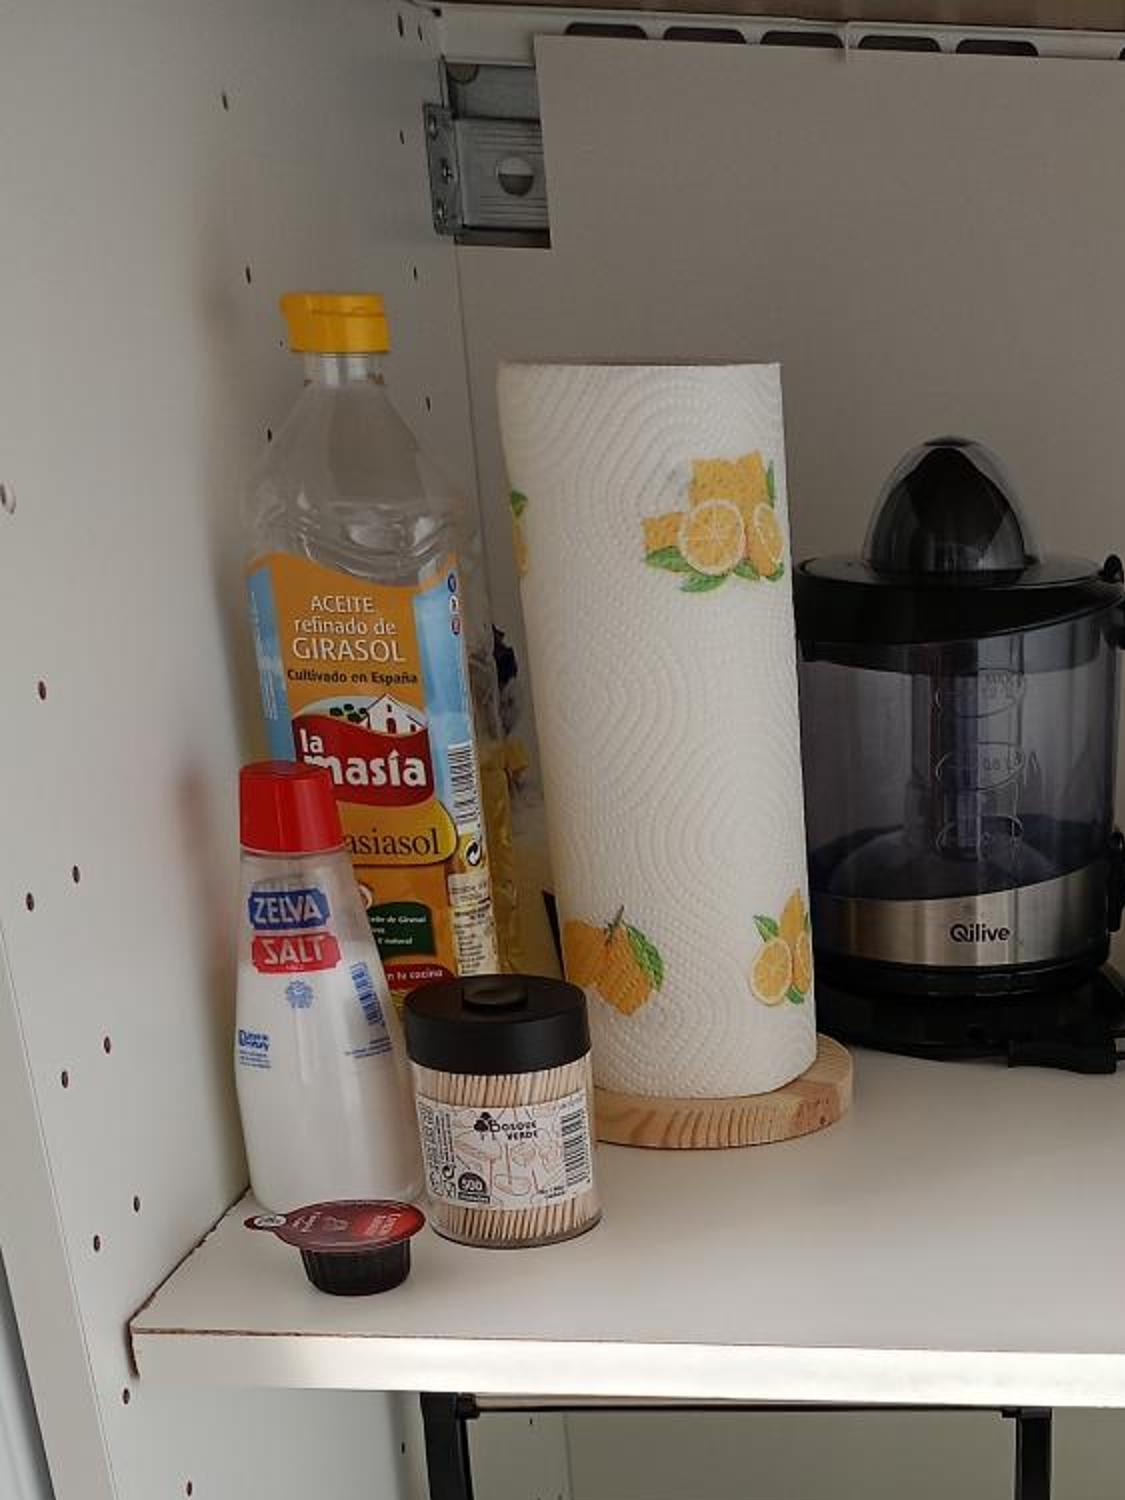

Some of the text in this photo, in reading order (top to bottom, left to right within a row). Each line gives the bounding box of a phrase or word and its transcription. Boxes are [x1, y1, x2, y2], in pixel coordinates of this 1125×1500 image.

[311, 595, 376, 613] ACEITE
[294, 615, 397, 635] refinado de
[292, 637, 407, 662] GIRASOL
[287, 669, 417, 685] Cultivado en España
[299, 728, 324, 753] la
[343, 828, 440, 856] asiasol
[253, 895, 323, 924] ZELVA
[950, 923, 1010, 942] Qilive
[261, 936, 326, 965] SALT
